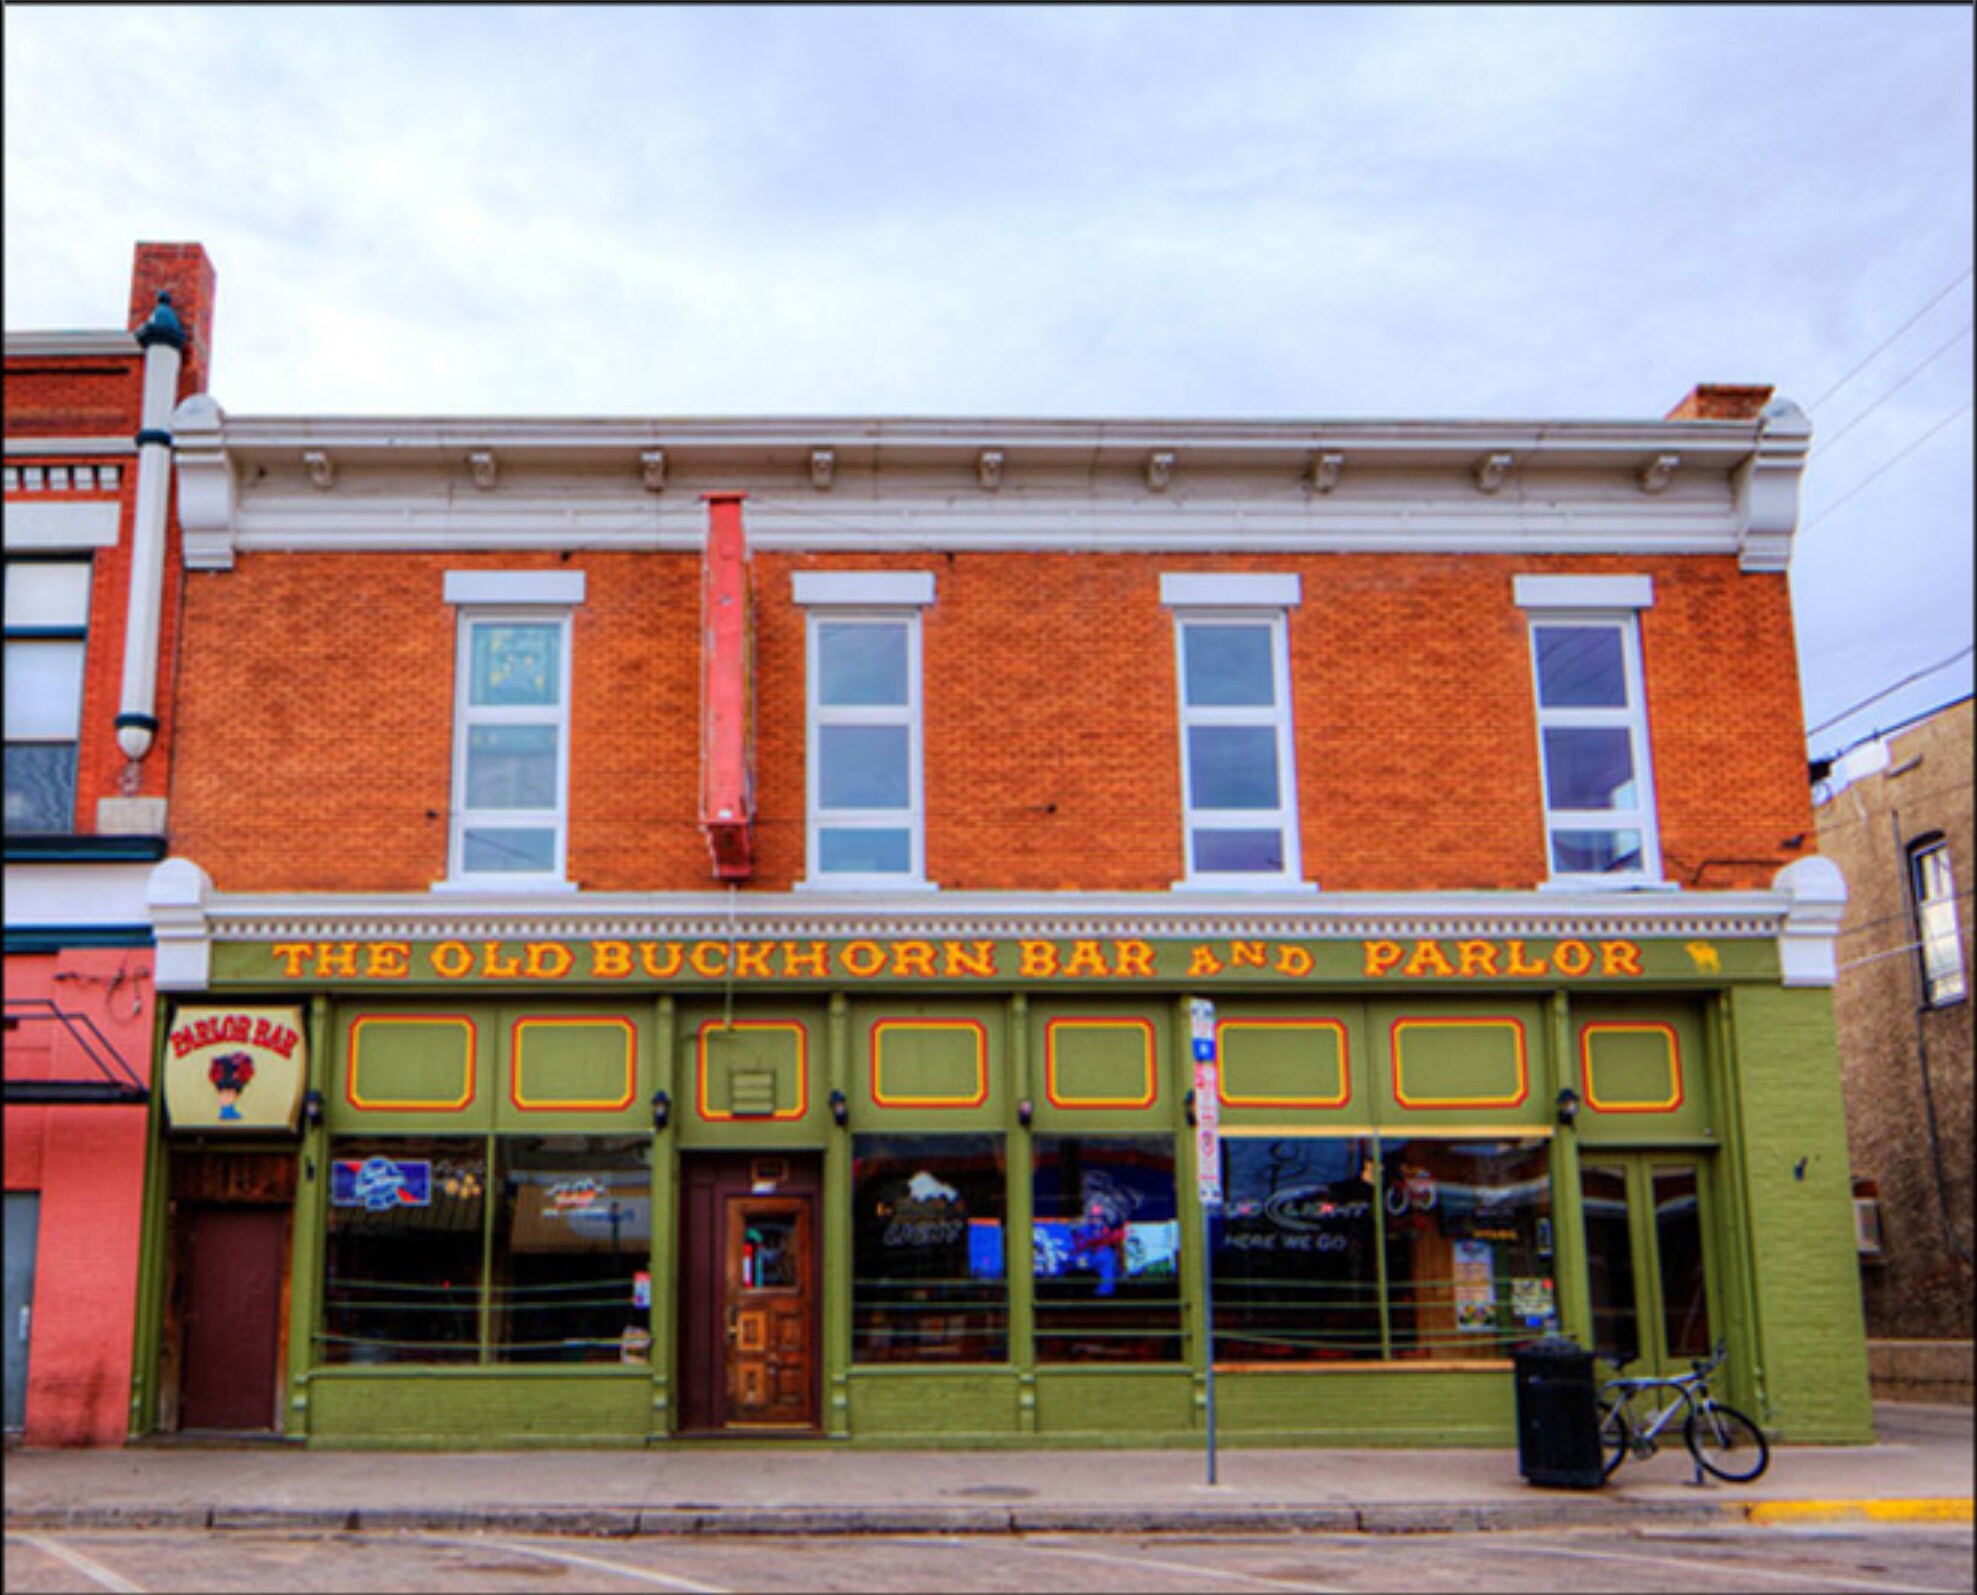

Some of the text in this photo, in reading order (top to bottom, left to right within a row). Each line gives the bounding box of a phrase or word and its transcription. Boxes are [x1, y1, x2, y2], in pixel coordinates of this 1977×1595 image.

[272, 939, 1646, 978] THE OLD BUCKHORN BAR AND PARLOR
[170, 1013, 299, 1060] PARLOR BAR
